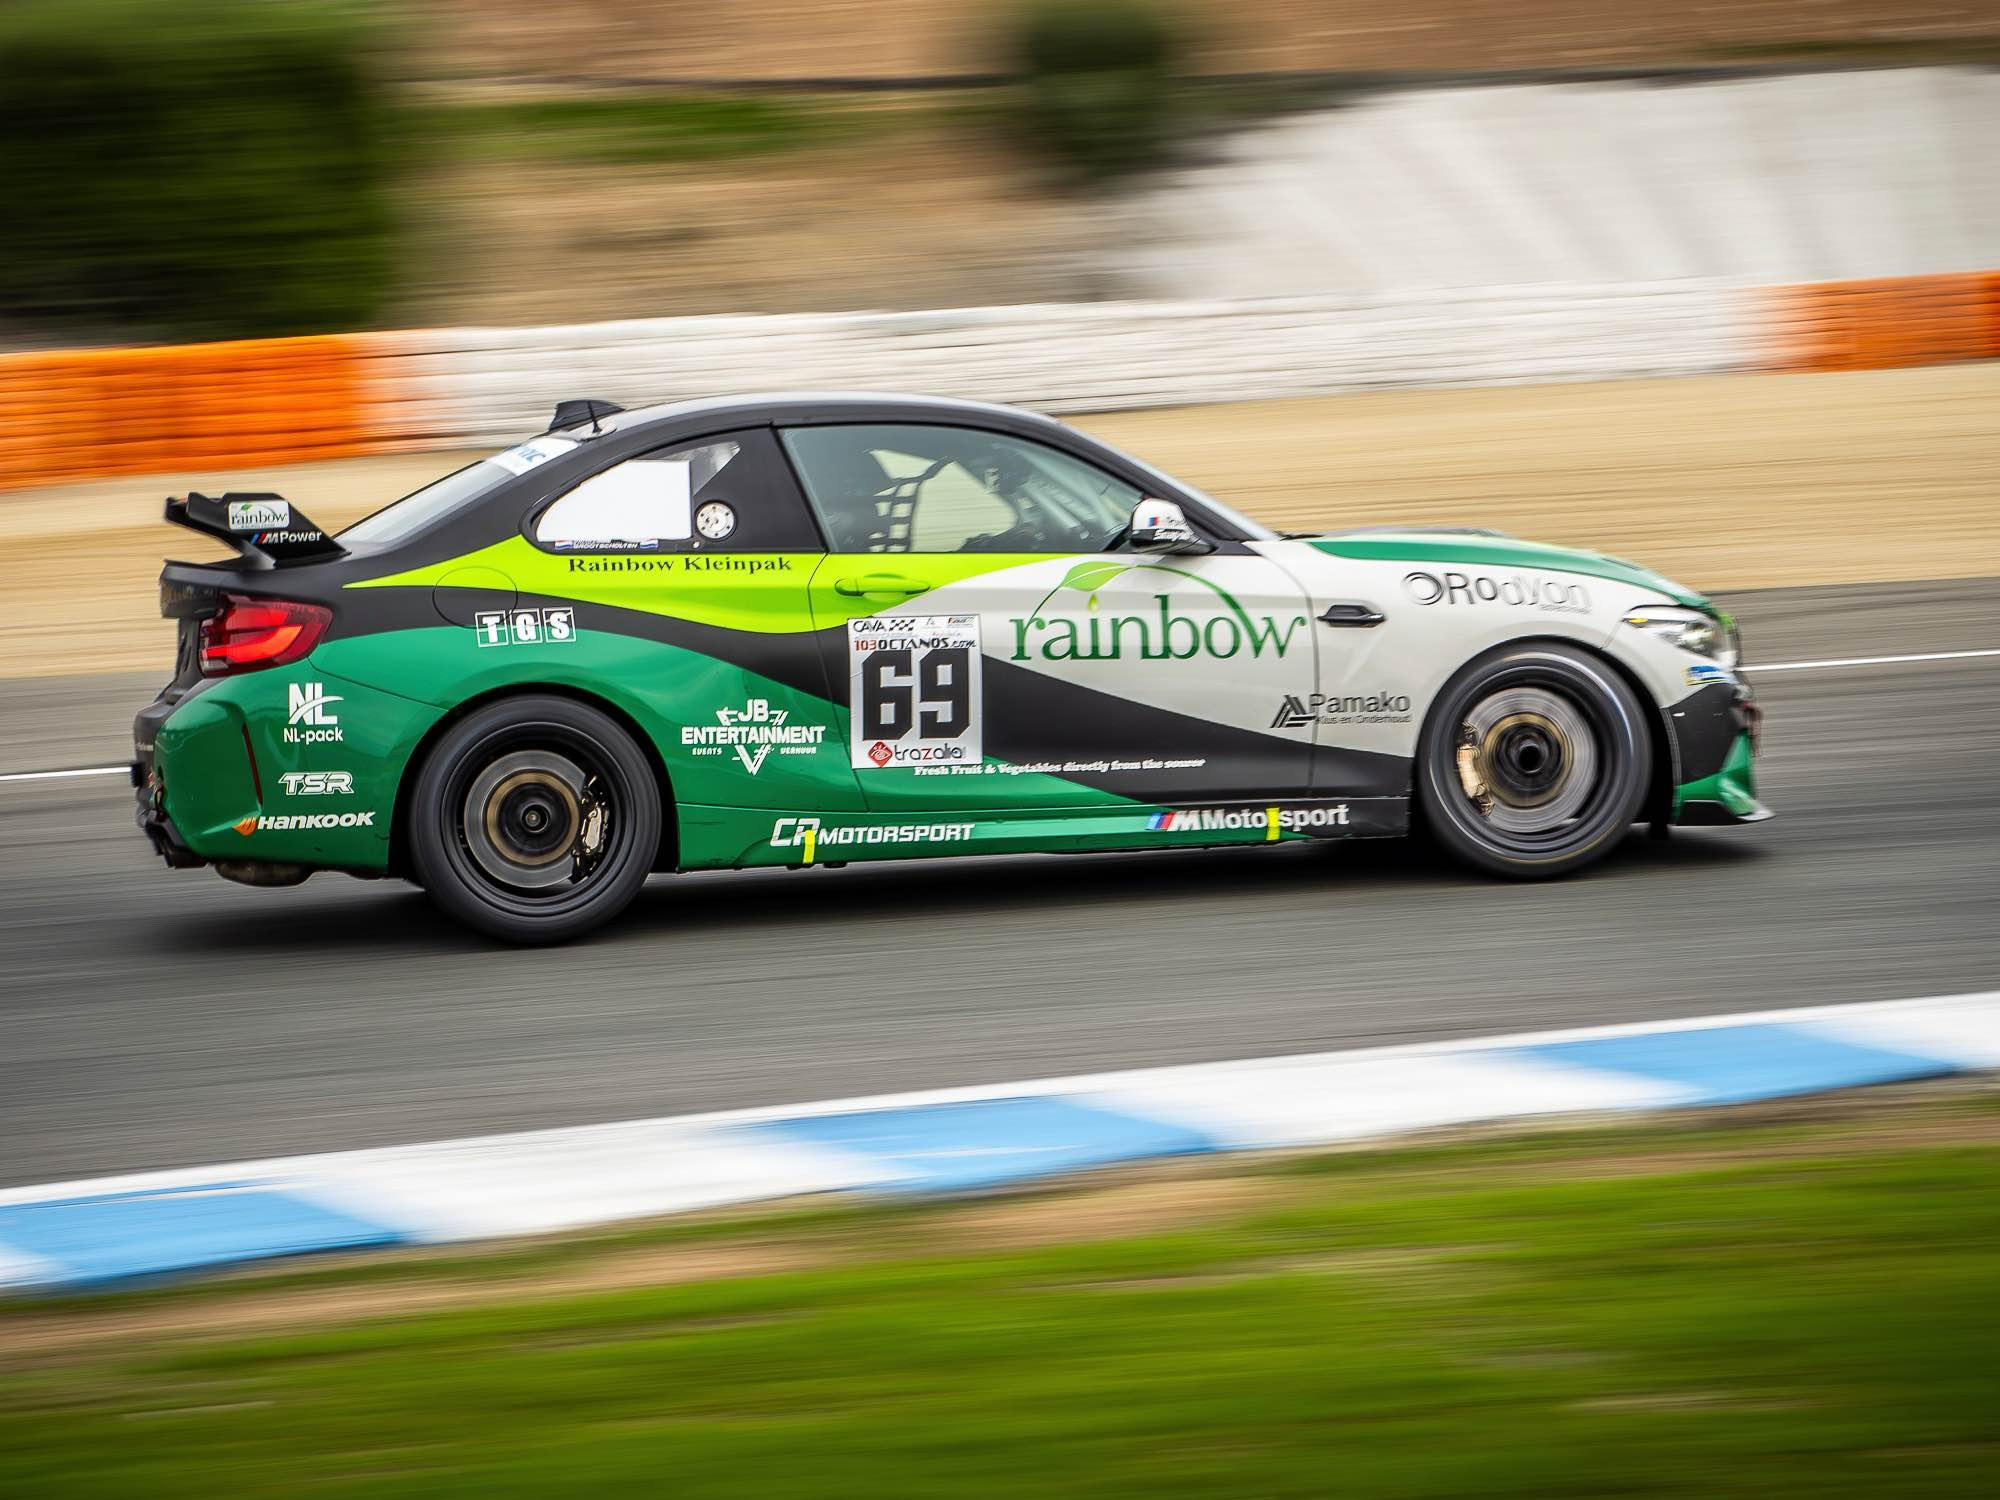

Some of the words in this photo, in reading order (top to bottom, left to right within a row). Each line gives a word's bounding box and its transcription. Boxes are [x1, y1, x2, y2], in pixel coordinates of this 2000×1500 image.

[231, 510, 288, 525] rainbow
[569, 558, 674, 572] Rainbow
[684, 556, 792, 574] Kleinpak
[478, 609, 574, 645] TGS
[1009, 594, 1307, 661] rainbow
[288, 682, 342, 725] NL
[862, 648, 971, 741] 69
[1309, 691, 1411, 713] Pamako
[737, 699, 769, 722] JB
[284, 727, 343, 745] NL-pack
[681, 726, 826, 744] ENTERTAINMENT
[914, 765, 949, 775] Fresh
[951, 764, 983, 775] Fruit
[985, 764, 996, 774] &
[1142, 759, 1163, 769] the
[278, 771, 355, 795] TSR
[818, 824, 975, 845] MOTORSPORT
